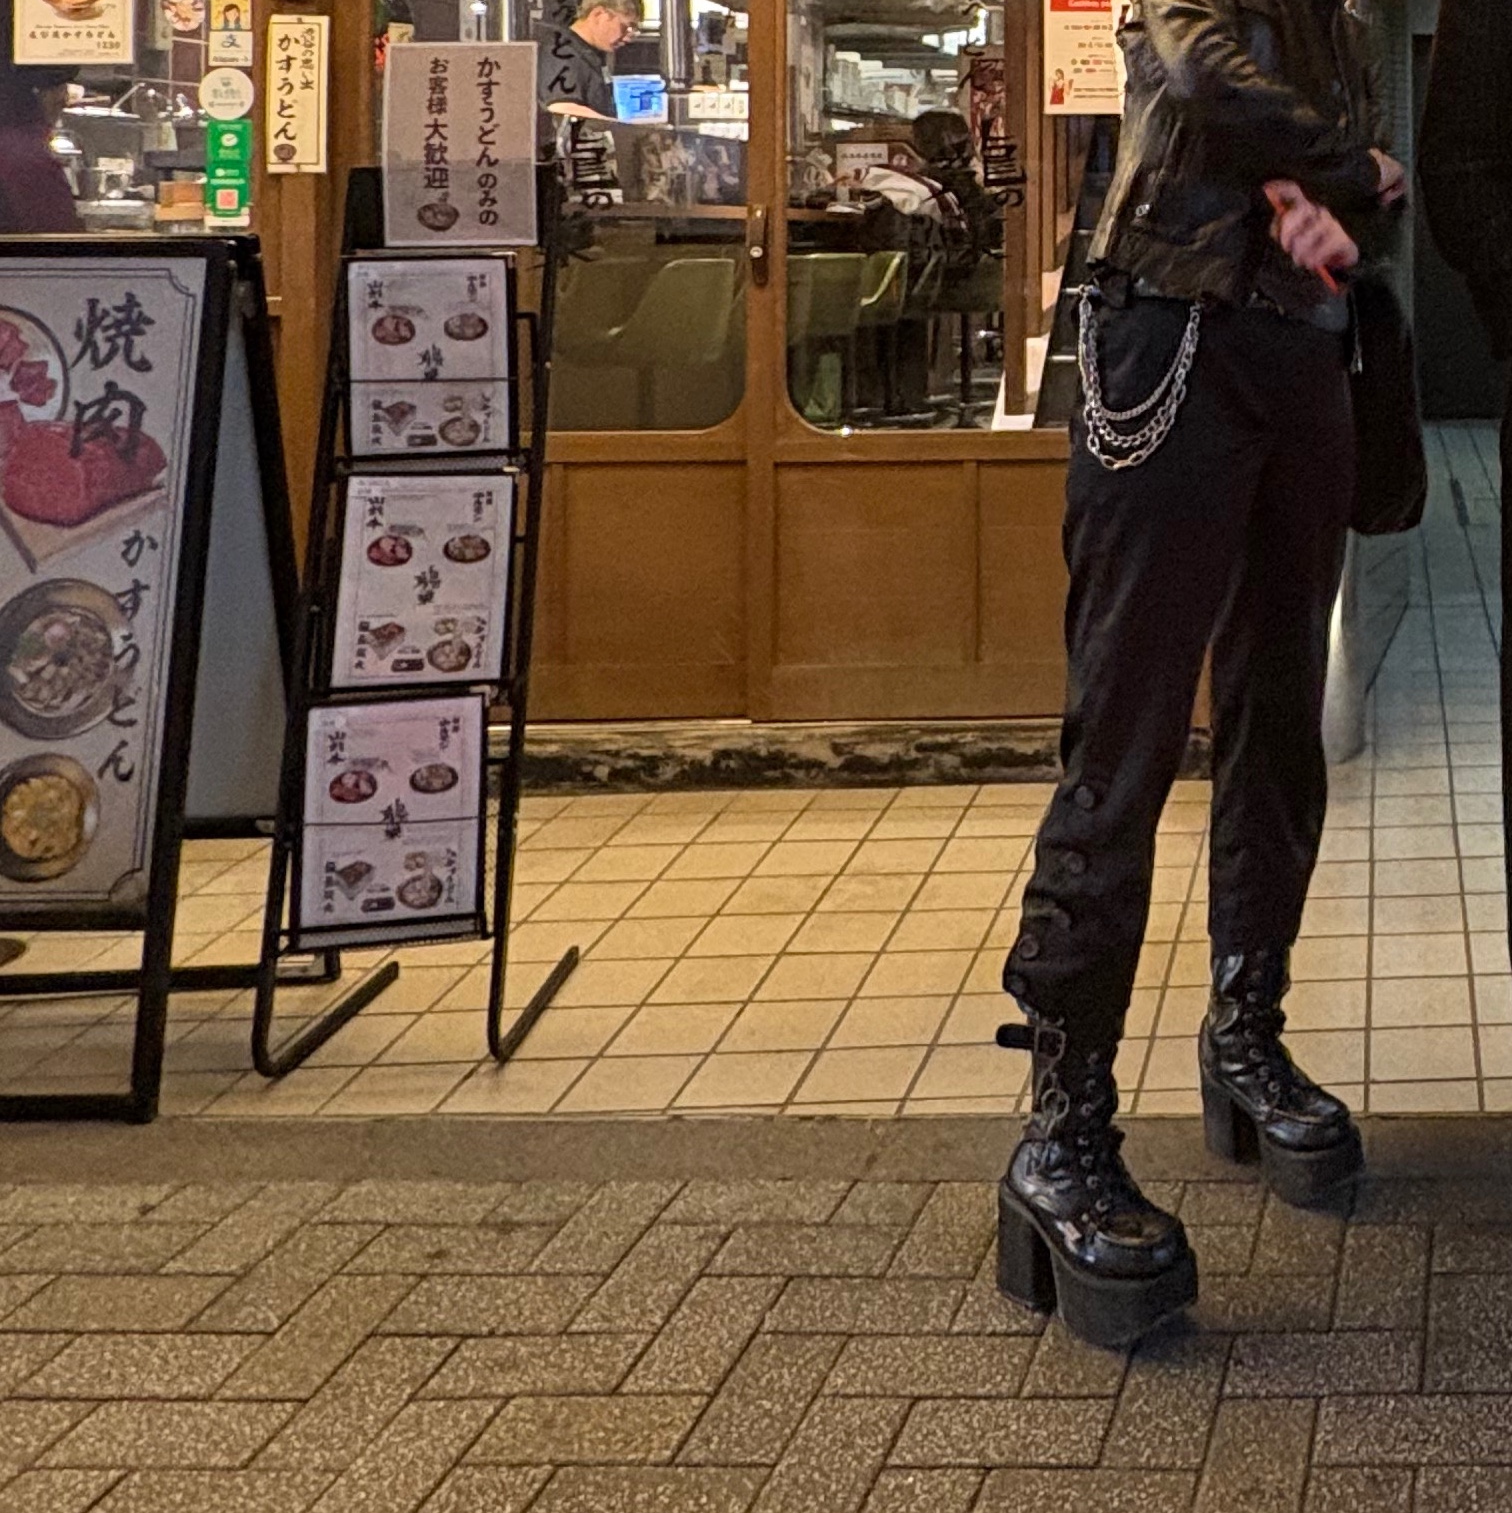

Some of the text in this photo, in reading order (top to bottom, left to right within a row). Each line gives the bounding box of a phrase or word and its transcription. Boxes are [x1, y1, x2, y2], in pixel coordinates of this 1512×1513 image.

[273, 33, 301, 142] かすうどん
[423, 55, 451, 192] お客様大歓迎
[475, 55, 502, 228] かすうどんのみの
[70, 290, 157, 464] 焼肉
[98, 528, 160, 784] かすうどん
